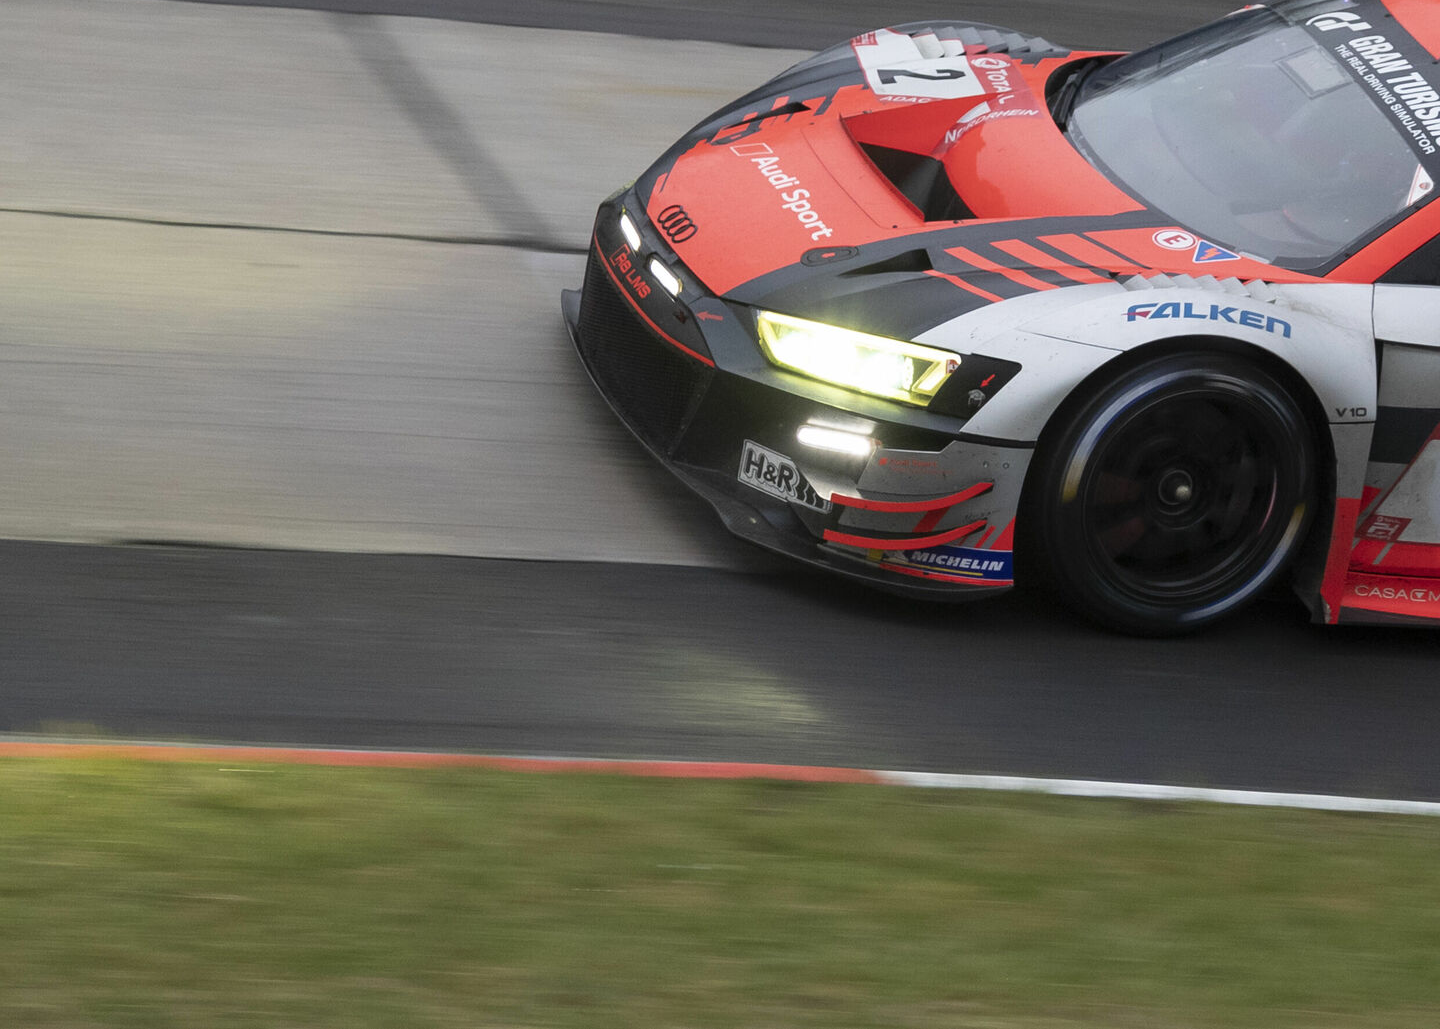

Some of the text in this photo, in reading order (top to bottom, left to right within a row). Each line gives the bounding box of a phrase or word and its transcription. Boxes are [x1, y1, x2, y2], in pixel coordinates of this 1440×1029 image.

[1348, 35, 1413, 74] GRAN
[877, 69, 967, 84] 2
[879, 94, 931, 104] ADAC
[1334, 43, 1436, 155] THE REAL DRIVING SIMULATOR
[751, 156, 834, 241] Audi Sport
[626, 268, 651, 299] LMS
[743, 447, 795, 493] H&R
[910, 550, 1005, 572] MICHELIN
